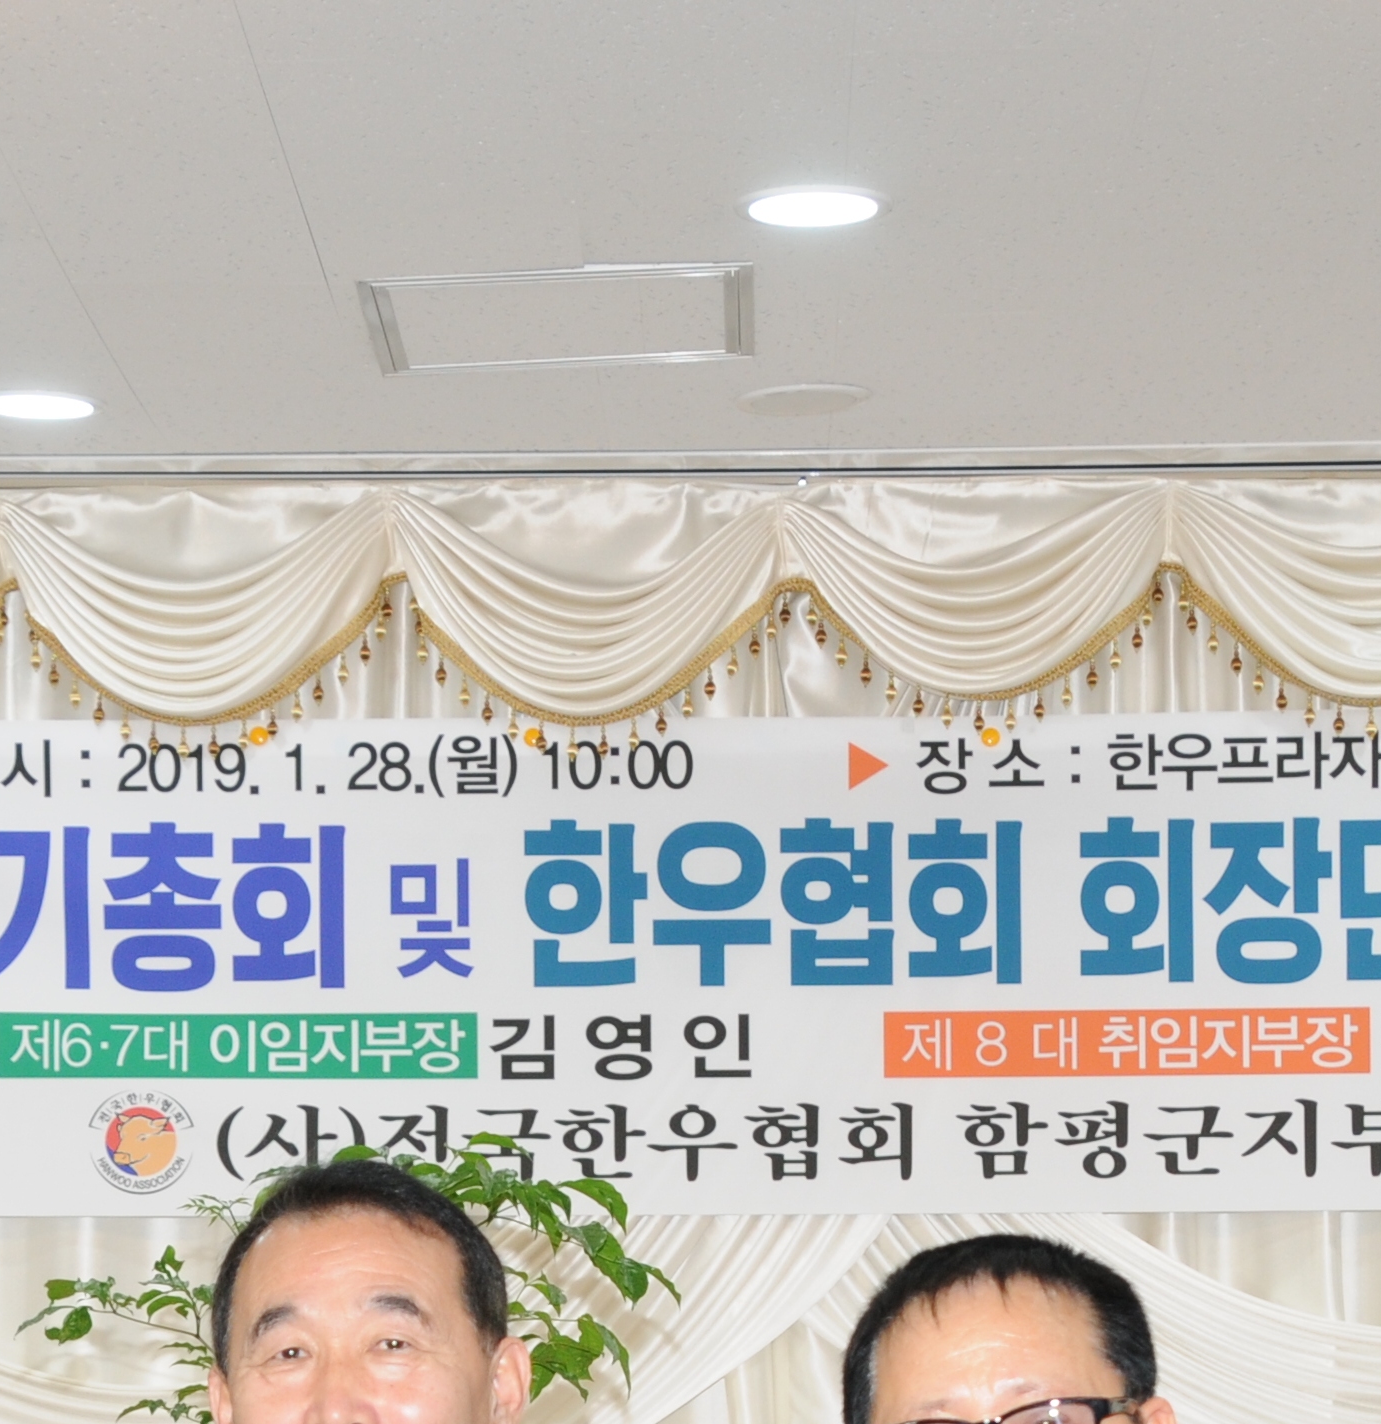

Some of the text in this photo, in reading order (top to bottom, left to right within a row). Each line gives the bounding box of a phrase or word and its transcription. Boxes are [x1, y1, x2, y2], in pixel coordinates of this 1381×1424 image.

[1, 740, 53, 799] 시
[118, 744, 260, 796] 2019.
[286, 744, 326, 796] 1.
[348, 734, 519, 799] 28.(월)
[543, 743, 695, 791] 10:00
[917, 738, 975, 795] 장
[988, 746, 1046, 789] 소
[391, 858, 474, 980] 및
[524, 818, 1024, 988] 한우협회
[11, 1019, 190, 1074] 제6·7대
[210, 1019, 467, 1075] 이임지부장
[1099, 1014, 1360, 1069] 취임지부장
[217, 1102, 914, 1181] (사)전국한우협회
[97, 1157, 185, 1189] HANWOO ASSOCIATION
